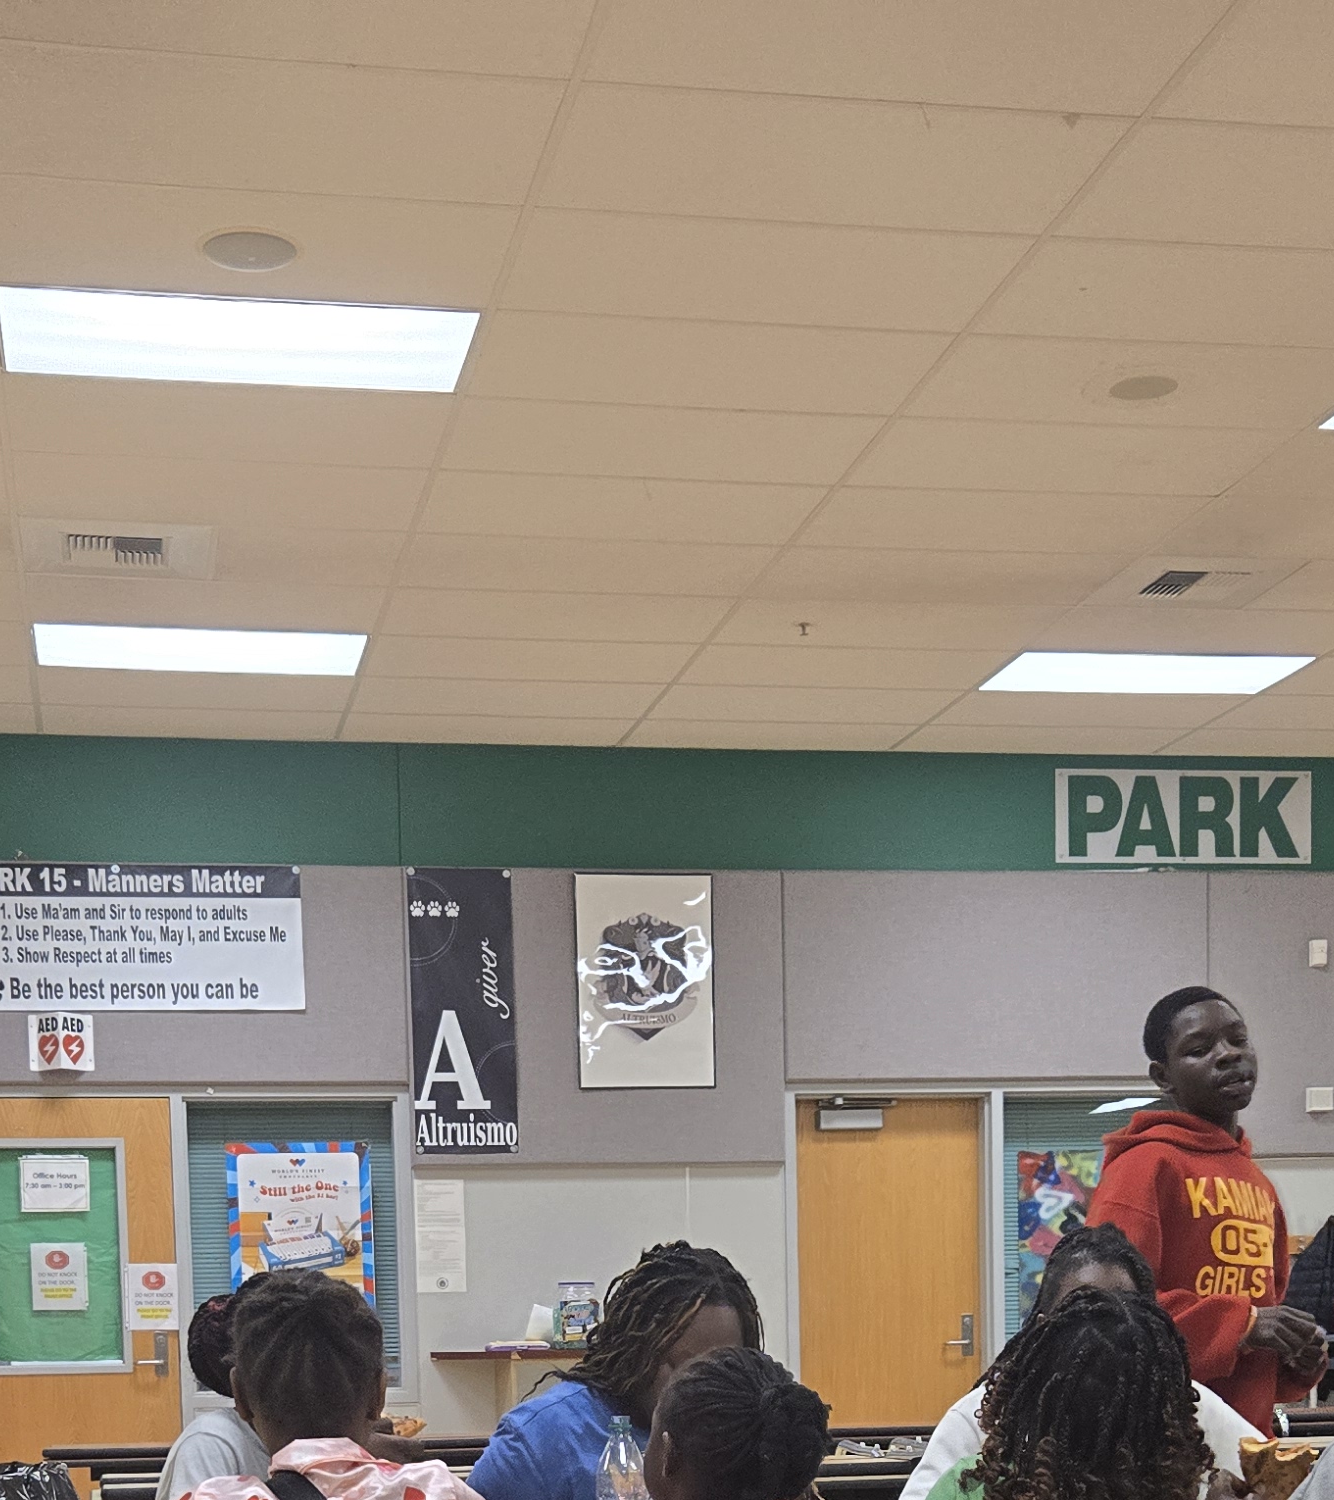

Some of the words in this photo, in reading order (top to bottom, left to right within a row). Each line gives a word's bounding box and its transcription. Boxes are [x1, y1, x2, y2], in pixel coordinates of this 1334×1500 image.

[1066, 775, 1301, 858] PARK
[38, 867, 67, 893] 15
[86, 868, 185, 894] Manners
[190, 869, 266, 895] Matter
[0, 903, 12, 920] 1.
[14, 903, 38, 921] Use
[41, 903, 81, 921] Ma'am
[84, 904, 106, 921] and
[108, 903, 127, 921] Sir
[130, 905, 143, 922] to
[145, 904, 193, 926] respond
[196, 905, 208, 922] to
[211, 904, 249, 922] adults
[0, 924, 13, 942] 2.
[15, 925, 40, 943] Use
[42, 925, 87, 947] Please,
[89, 925, 128, 943] Thank
[129, 926, 157, 947] You,
[159, 926, 184, 948] May
[198, 926, 221, 944] and
[223, 926, 267, 944] Excuse
[269, 926, 288, 944] Me
[1, 946, 14, 964] 3.
[16, 946, 50, 964] Show
[53, 947, 103, 969] Respect
[105, 948, 118, 964] at
[121, 947, 136, 964] all
[138, 947, 173, 964] times
[9, 976, 32, 1001] Be
[36, 977, 64, 1001] the
[68, 977, 106, 1001] best
[110, 981, 167, 1005] person
[170, 981, 200, 1006] you
[204, 981, 235, 1001] can
[239, 977, 260, 1001] be
[476, 937, 510, 1020] giver
[37, 1017, 59, 1033] AED
[61, 1016, 84, 1033] AED
[414, 1009, 491, 1110] A
[416, 1112, 517, 1147] Altruismo
[25, 1182, 39, 1190] 7:30
[73, 1183, 86, 1191] pm
[32, 1171, 55, 1180] Office
[56, 1171, 78, 1180] Hours
[259, 1184, 288, 1197] Still
[290, 1183, 312, 1195] the
[315, 1179, 340, 1193] One
[1184, 1176, 1275, 1222] KAMIA
[1195, 1265, 1267, 1299] GIRLS
